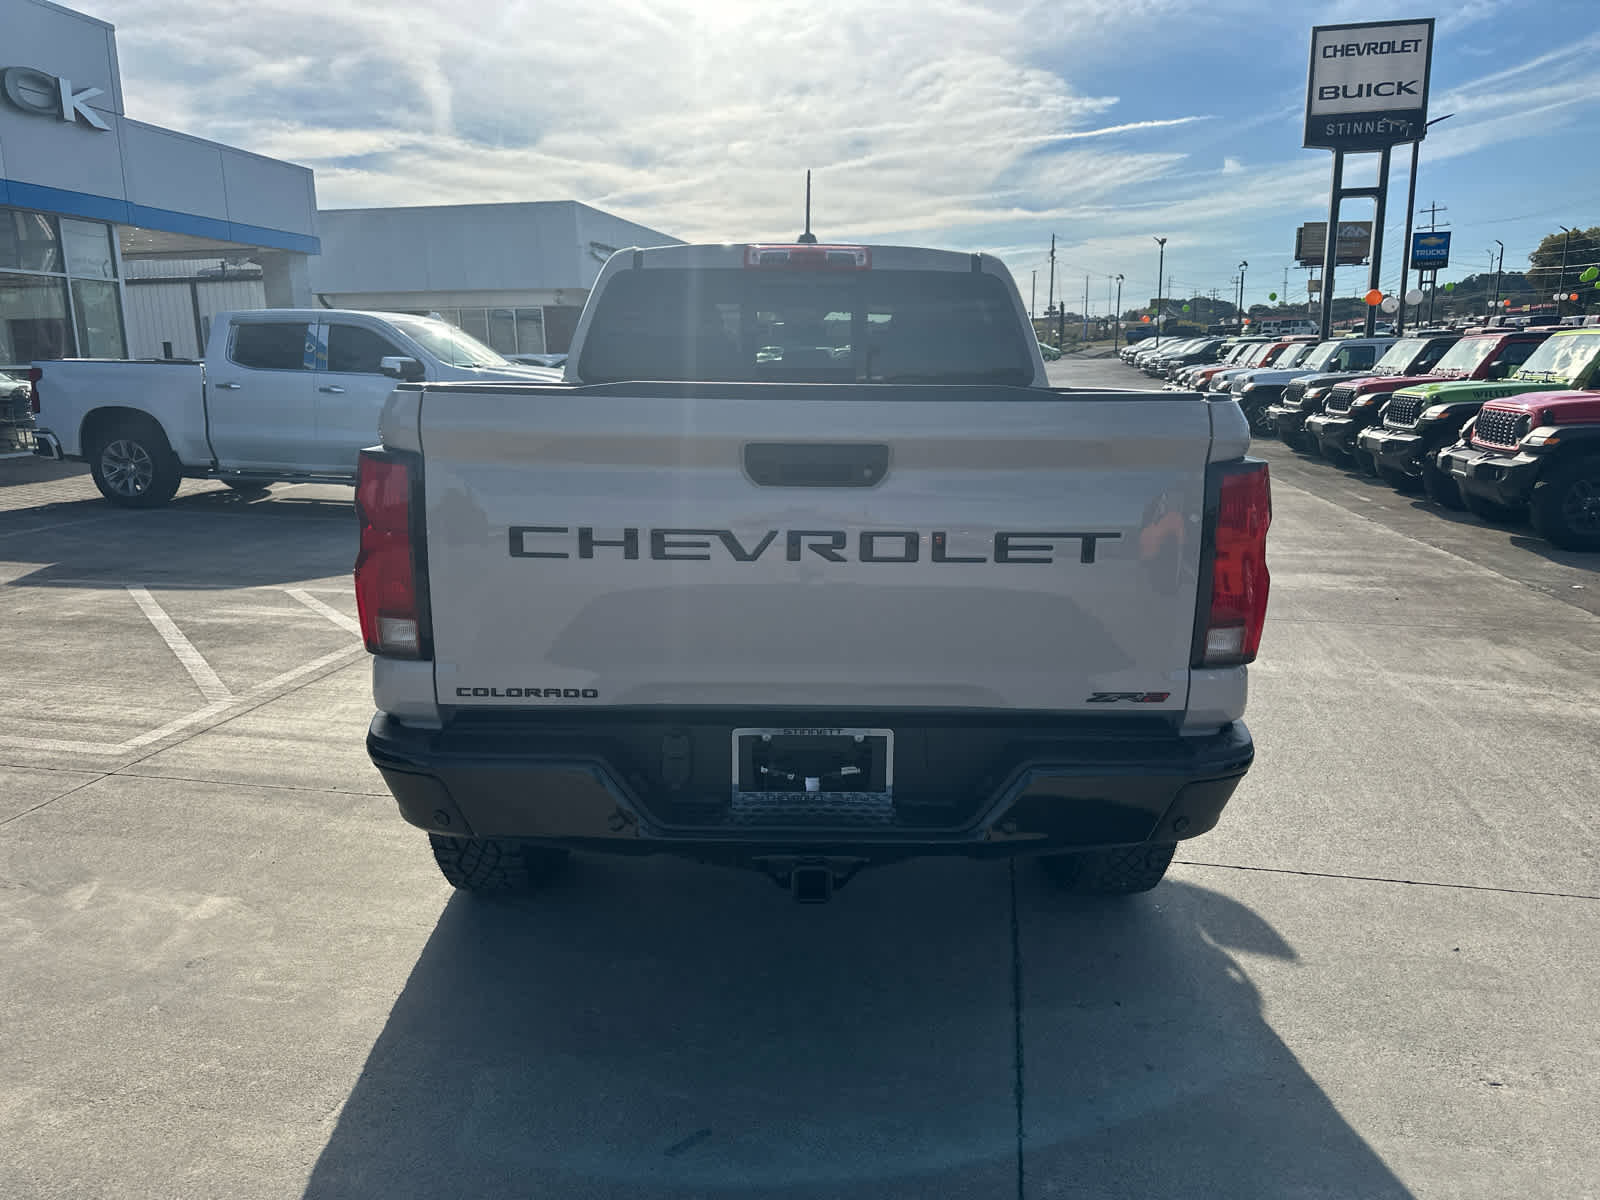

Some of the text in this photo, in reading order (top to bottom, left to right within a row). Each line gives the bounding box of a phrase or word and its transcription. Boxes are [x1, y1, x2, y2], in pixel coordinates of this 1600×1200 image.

[1323, 39, 1422, 58] CHEVROLET
[1319, 80, 1418, 100] BUICK
[1416, 249, 1448, 257] TRUCKS
[1472, 389, 1512, 400] WILLYS
[509, 526, 1121, 564] CHEVROLET
[456, 687, 598, 698] COLORADO
[1086, 692, 1170, 703] ZR2
